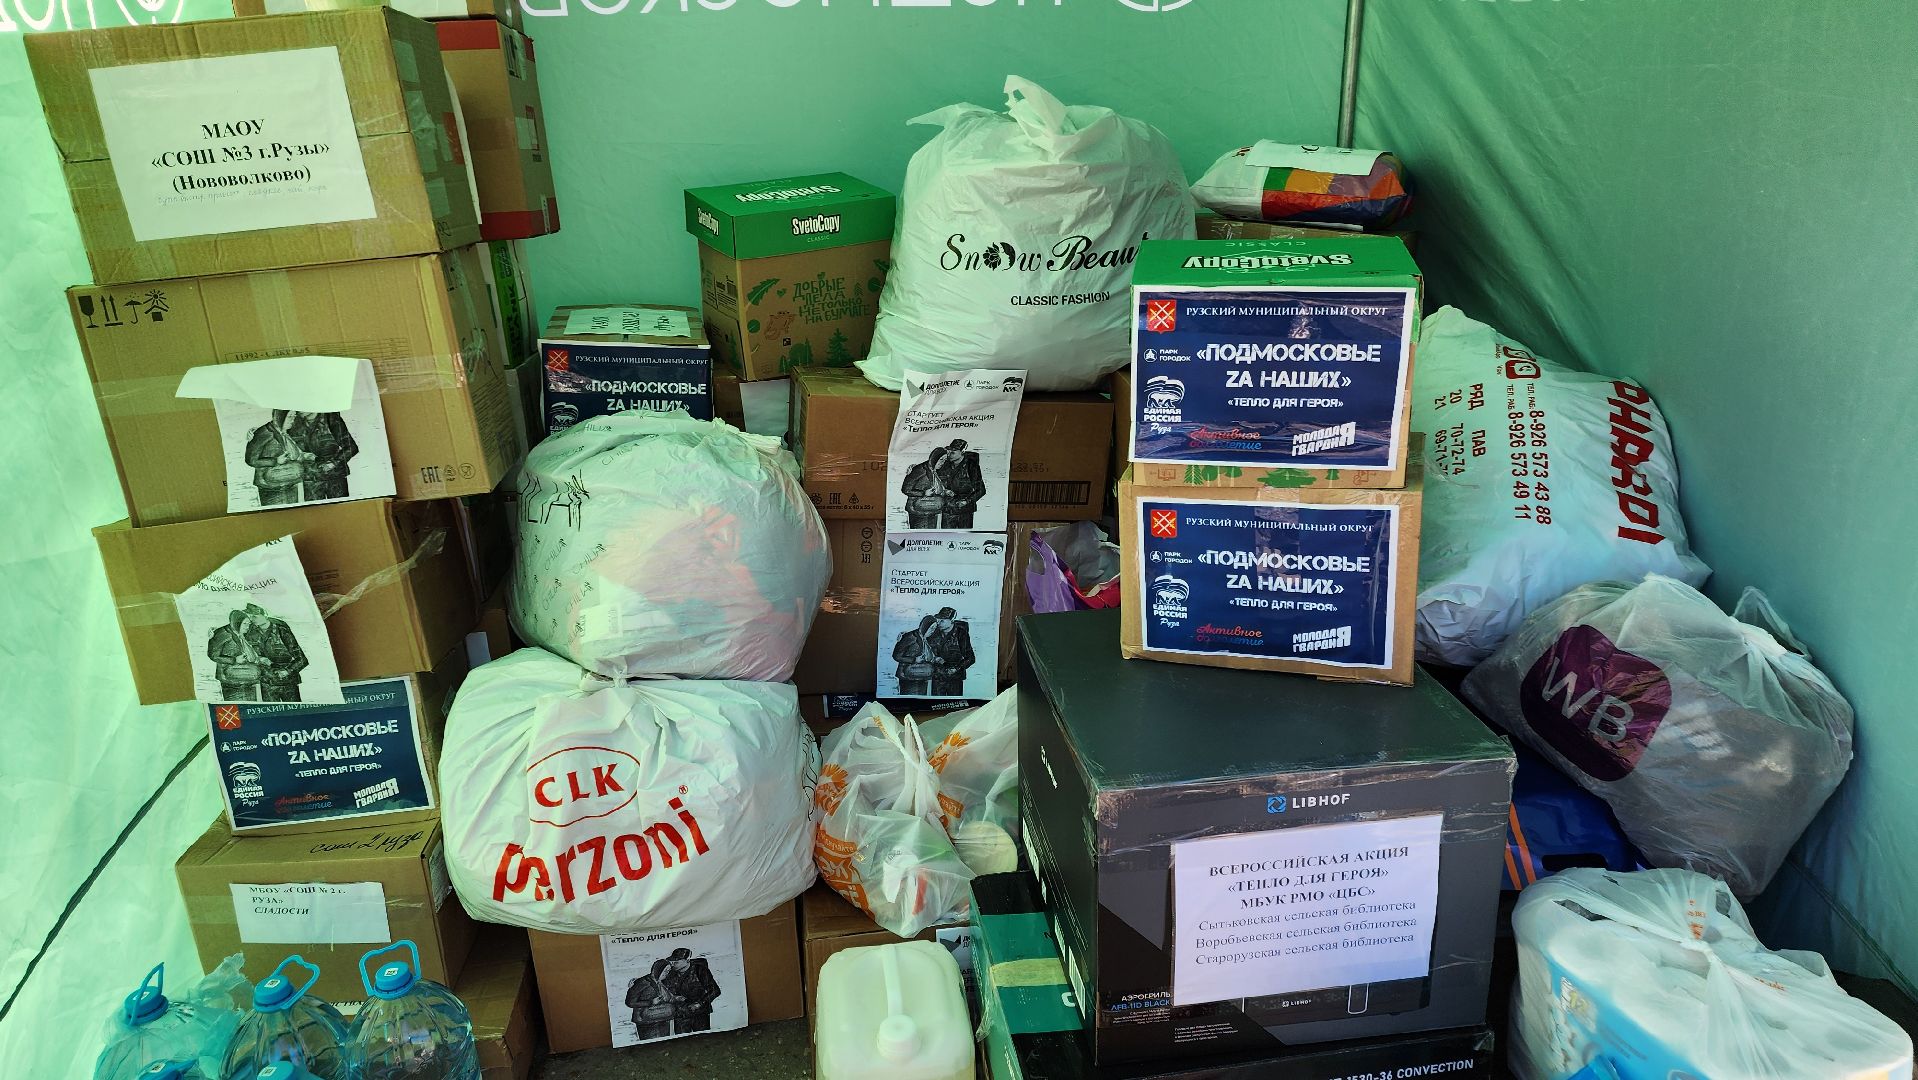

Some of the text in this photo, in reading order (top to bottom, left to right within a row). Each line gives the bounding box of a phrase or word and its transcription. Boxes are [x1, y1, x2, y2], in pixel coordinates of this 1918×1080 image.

[202, 119, 265, 139] МАОУ
[151, 142, 330, 168] «СОШ №3 г.Рузы»
[172, 165, 311, 194] (Нововолково)
[792, 215, 840, 236] SvetoCopy
[1047, 231, 1149, 271] Beau
[1184, 254, 1352, 269] SvetoCopy
[793, 277, 845, 301] ДОБРЫЕ
[1011, 291, 1110, 306] CLASSIC FASHION
[1186, 306, 1388, 316] РУЗСКИЙ МУНИЦИПАЛЬНЫЙ ОКРУГ
[575, 355, 610, 363] РУЗСКИЙ
[611, 357, 683, 365] МУНИЦИПАЛЬНЫЙ
[1196, 343, 1382, 365] «ПОДМОСКОВЬЕ
[585, 380, 707, 395] «ПОДМОСКОВЬЕ
[1260, 370, 1352, 389] НАШИХ»
[630, 399, 690, 412] НАШИХ»
[1227, 398, 1344, 410] «ТЕПЛО ДЛЯ ГЕРОЯ»
[1435, 395, 1446, 410] 21
[1150, 422, 1172, 434] Руза
[1467, 383, 1487, 457] РЯД ПАВ
[1508, 411, 1526, 448] 8-926
[1529, 410, 1547, 447] 8-926
[1293, 421, 1356, 446] МОЛОДАЯ
[1450, 389, 1466, 475] 20 70-72-74
[1510, 452, 1528, 477] 573
[1531, 452, 1549, 479] 573
[1513, 480, 1530, 499] 49
[1535, 482, 1550, 502] 43
[1515, 504, 1531, 520] 11
[1536, 505, 1551, 525] 88
[1186, 518, 1374, 533] РУЗСКИЙ МУНИЦИПАЛЬНЫЙ ОКРУГ
[1197, 550, 1370, 573] «ПОДМОСКОВЬЕ
[1257, 575, 1344, 595] НАШИХ»
[1153, 604, 1187, 612] ЕДИНАЯ
[1229, 597, 1338, 612] «ТЕПЛО ДЛЯ ГЕРОЯ»
[1153, 611, 1187, 619] РОССИЯ
[1160, 618, 1180, 628] Руза
[1196, 624, 1262, 637] Активное
[1292, 626, 1352, 648] МОЛОДАЯ
[247, 693, 396, 715] РУЗСКИЙ ОКРУГ
[1541, 657, 1635, 743] WB
[261, 720, 399, 747] «ПОДМОСКОВЬЕ
[315, 743, 382, 762] НАШИХ»
[295, 762, 382, 778] «ТЕПЛО ДЛЯ ГЕРОЯ»
[233, 785, 263, 793] ЕДИНАЯ
[234, 791, 264, 799] РОССИЯ
[353, 778, 399, 799] МОЛОДАЯ
[534, 763, 625, 808] CLK
[1293, 793, 1351, 809] LIBHOF
[1209, 846, 1409, 877] ВСЕРОССИЙСКАЯ АКЦИЯ
[249, 886, 281, 894] МБОУ
[283, 886, 316, 894] «СОШ
[1228, 868, 1389, 893] «ТЕПЛО ДЛЯ ГЕРОЯ»
[1240, 886, 1376, 910] МБУК РМО «ЦБС»
[254, 907, 309, 915] СЛАДОСТИ
[1198, 899, 1416, 932] Сытьковская сельская библиотека
[611, 935, 645, 944] «ТЕПЛО
[646, 933, 666, 943] ДЛЯ
[666, 928, 698, 939] ГЕРОЯ»
[1196, 917, 1417, 949] Воробьевская сельская библиотека
[1195, 933, 1415, 966] Старорузская сельская библиотека
[1397, 1059, 1474, 1079] CONVECTION
